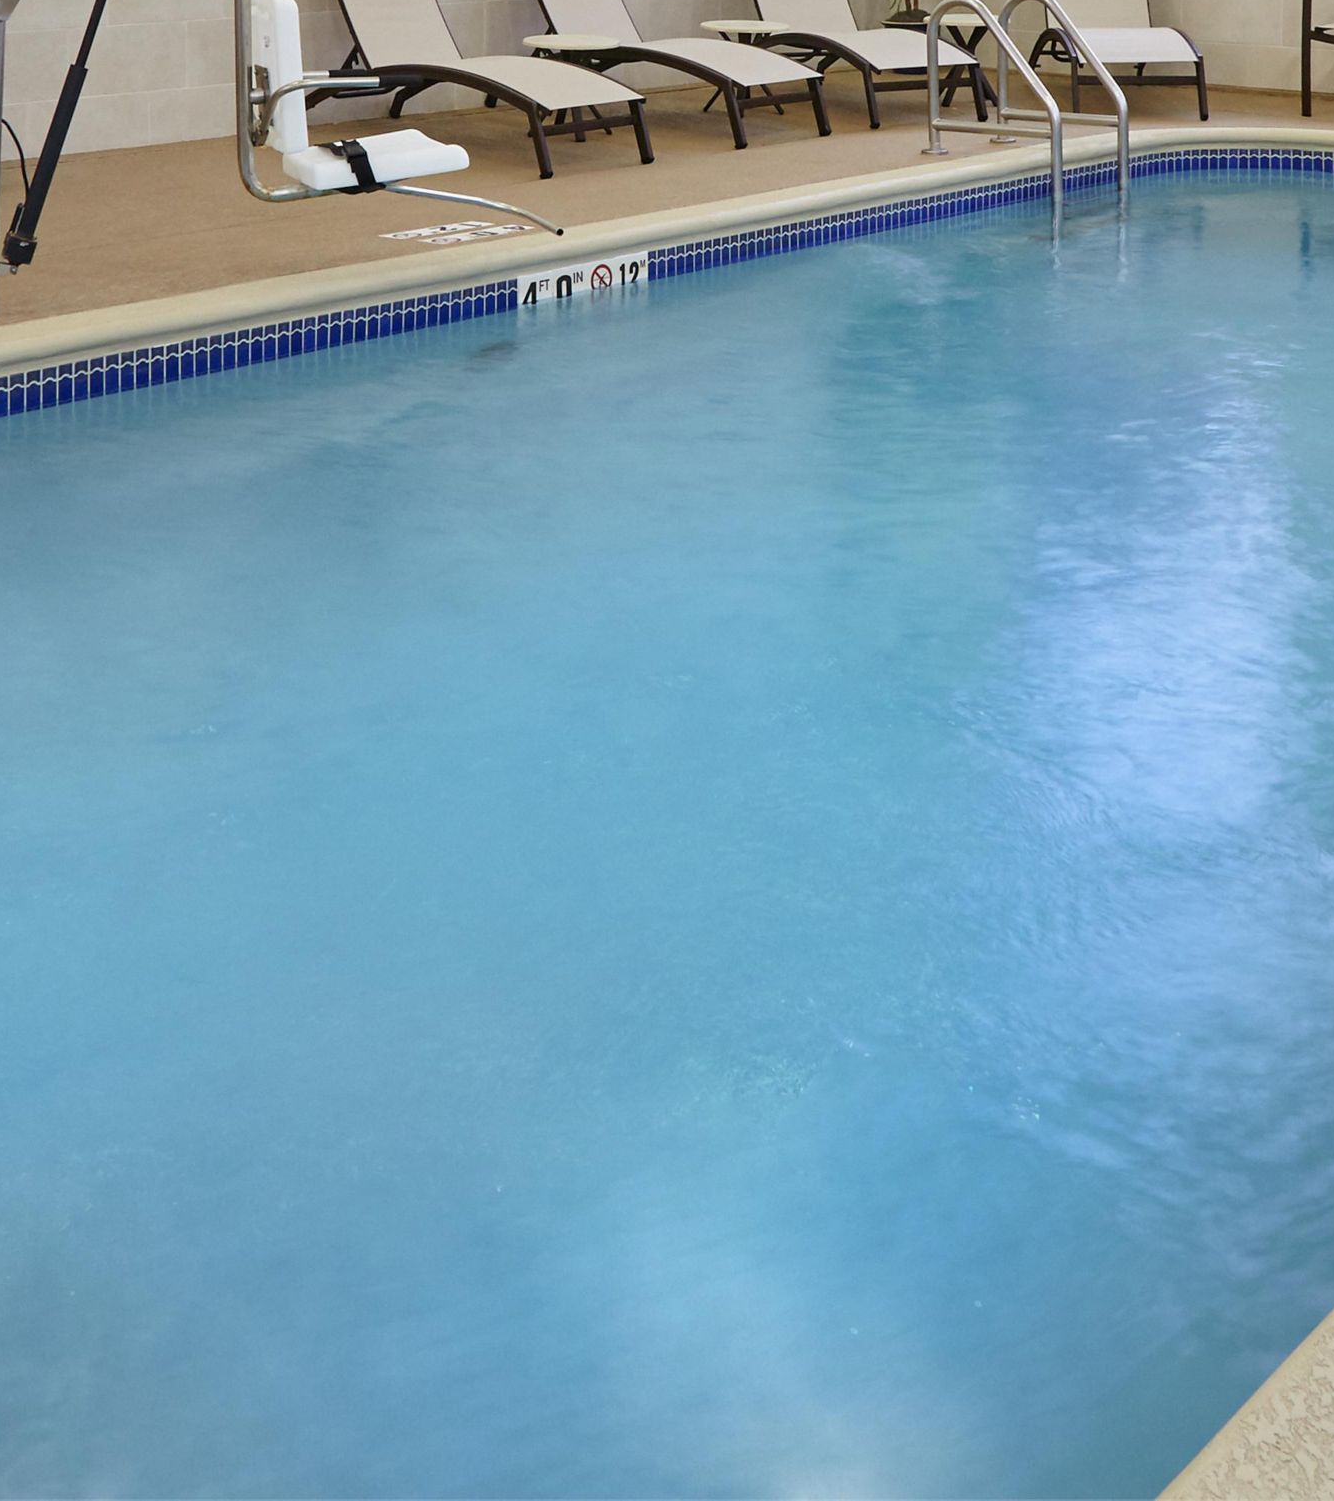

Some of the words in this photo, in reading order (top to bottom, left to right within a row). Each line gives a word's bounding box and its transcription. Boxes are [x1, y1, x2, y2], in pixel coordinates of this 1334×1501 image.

[522, 281, 537, 305] 4
[539, 279, 550, 292] FT
[573, 271, 584, 284] IN
